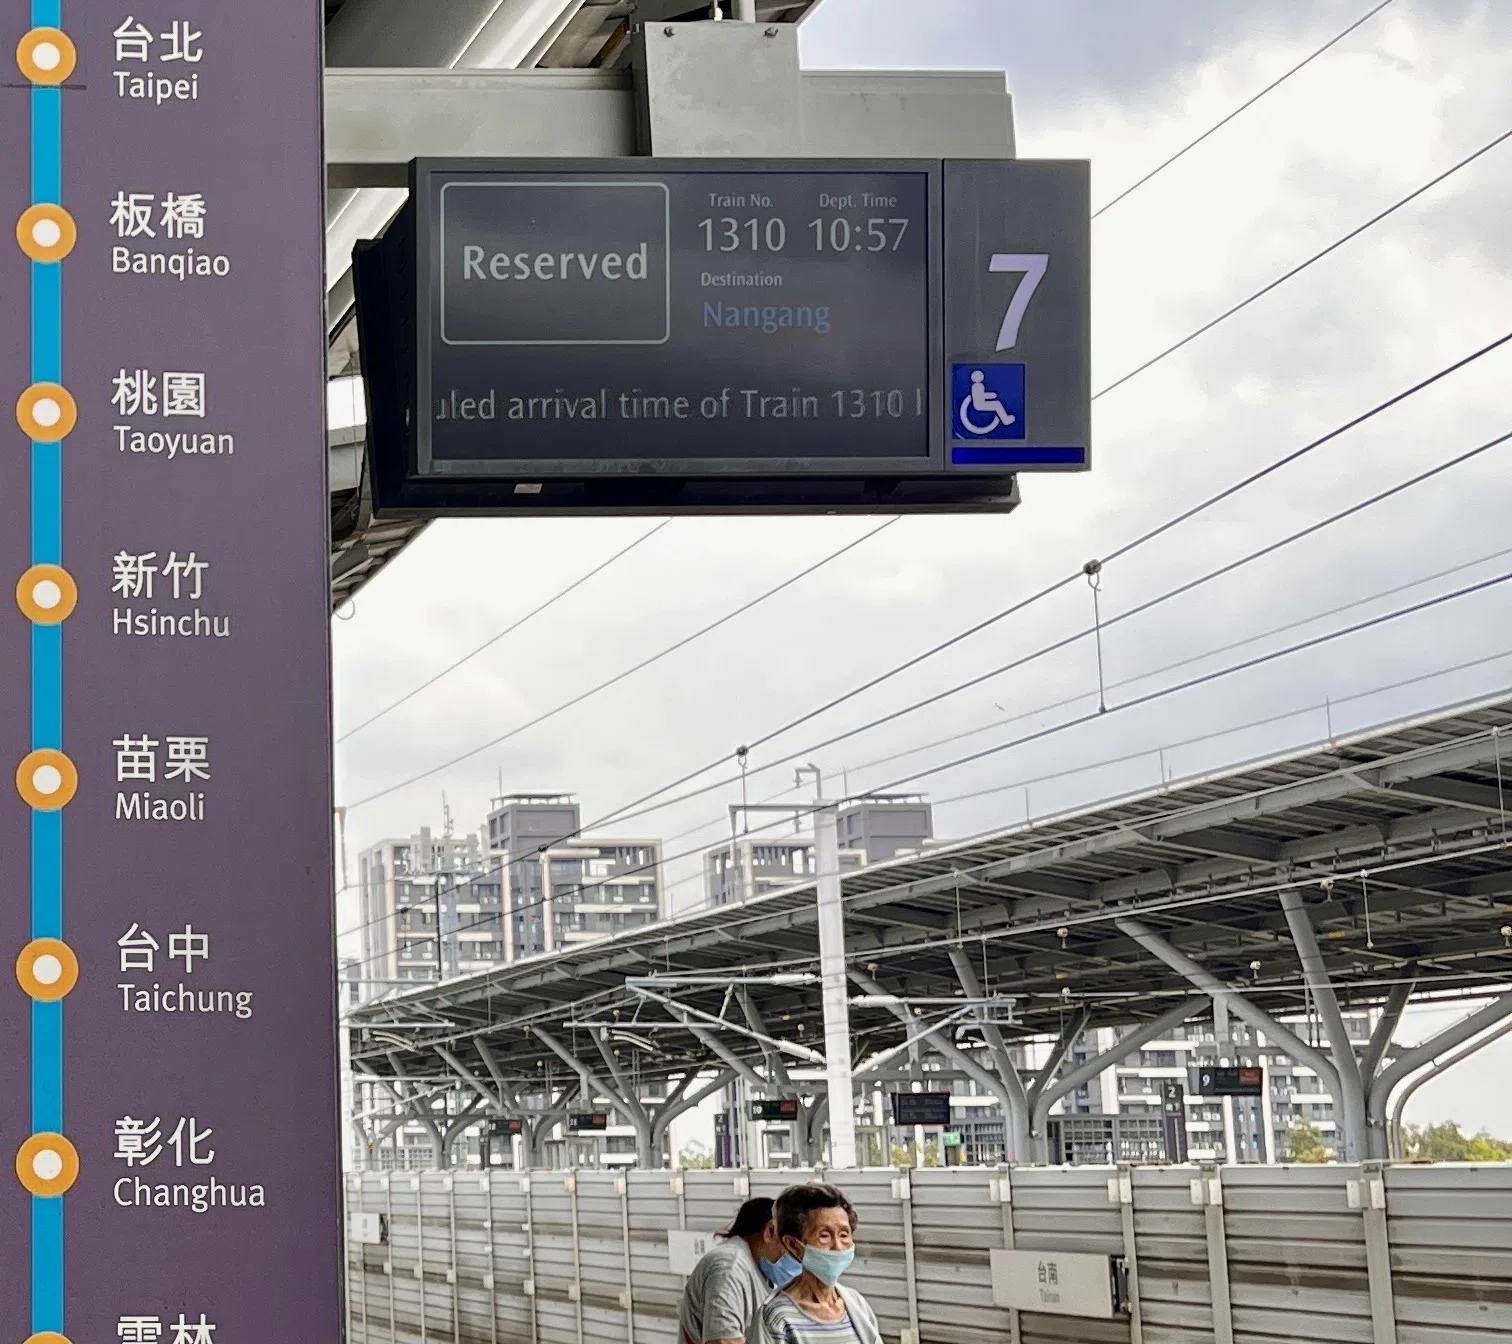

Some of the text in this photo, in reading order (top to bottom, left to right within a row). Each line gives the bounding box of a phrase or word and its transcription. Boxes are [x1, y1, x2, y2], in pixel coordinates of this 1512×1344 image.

[112, 15, 204, 63] 台北
[112, 71, 199, 105] Taipei
[109, 190, 207, 239] 板橋
[708, 193, 774, 208] Train No.
[819, 193, 897, 210] Dept. Time
[697, 217, 786, 252] 1310
[807, 217, 909, 252] 10:57
[111, 246, 230, 282] Banqiao
[463, 241, 648, 281] Reserved
[700, 271, 783, 288] Destination
[702, 300, 831, 334] Nangang
[988, 253, 1049, 351] 7
[110, 368, 206, 418] 桃園
[507, 388, 606, 420] arrival
[619, 388, 689, 420] time
[699, 387, 731, 419] of
[739, 387, 818, 419] Train
[831, 388, 905, 419] 1310
[113, 425, 234, 460] Taoyuan
[111, 550, 209, 600] 新竹
[112, 608, 230, 638] Hsinchu
[112, 733, 211, 783] 苗栗
[115, 792, 205, 822] Miaoli
[116, 922, 209, 974] 台中
[117, 983, 254, 1019] Taichung
[113, 1115, 216, 1167] 彰化
[113, 1176, 266, 1213] Changhua
